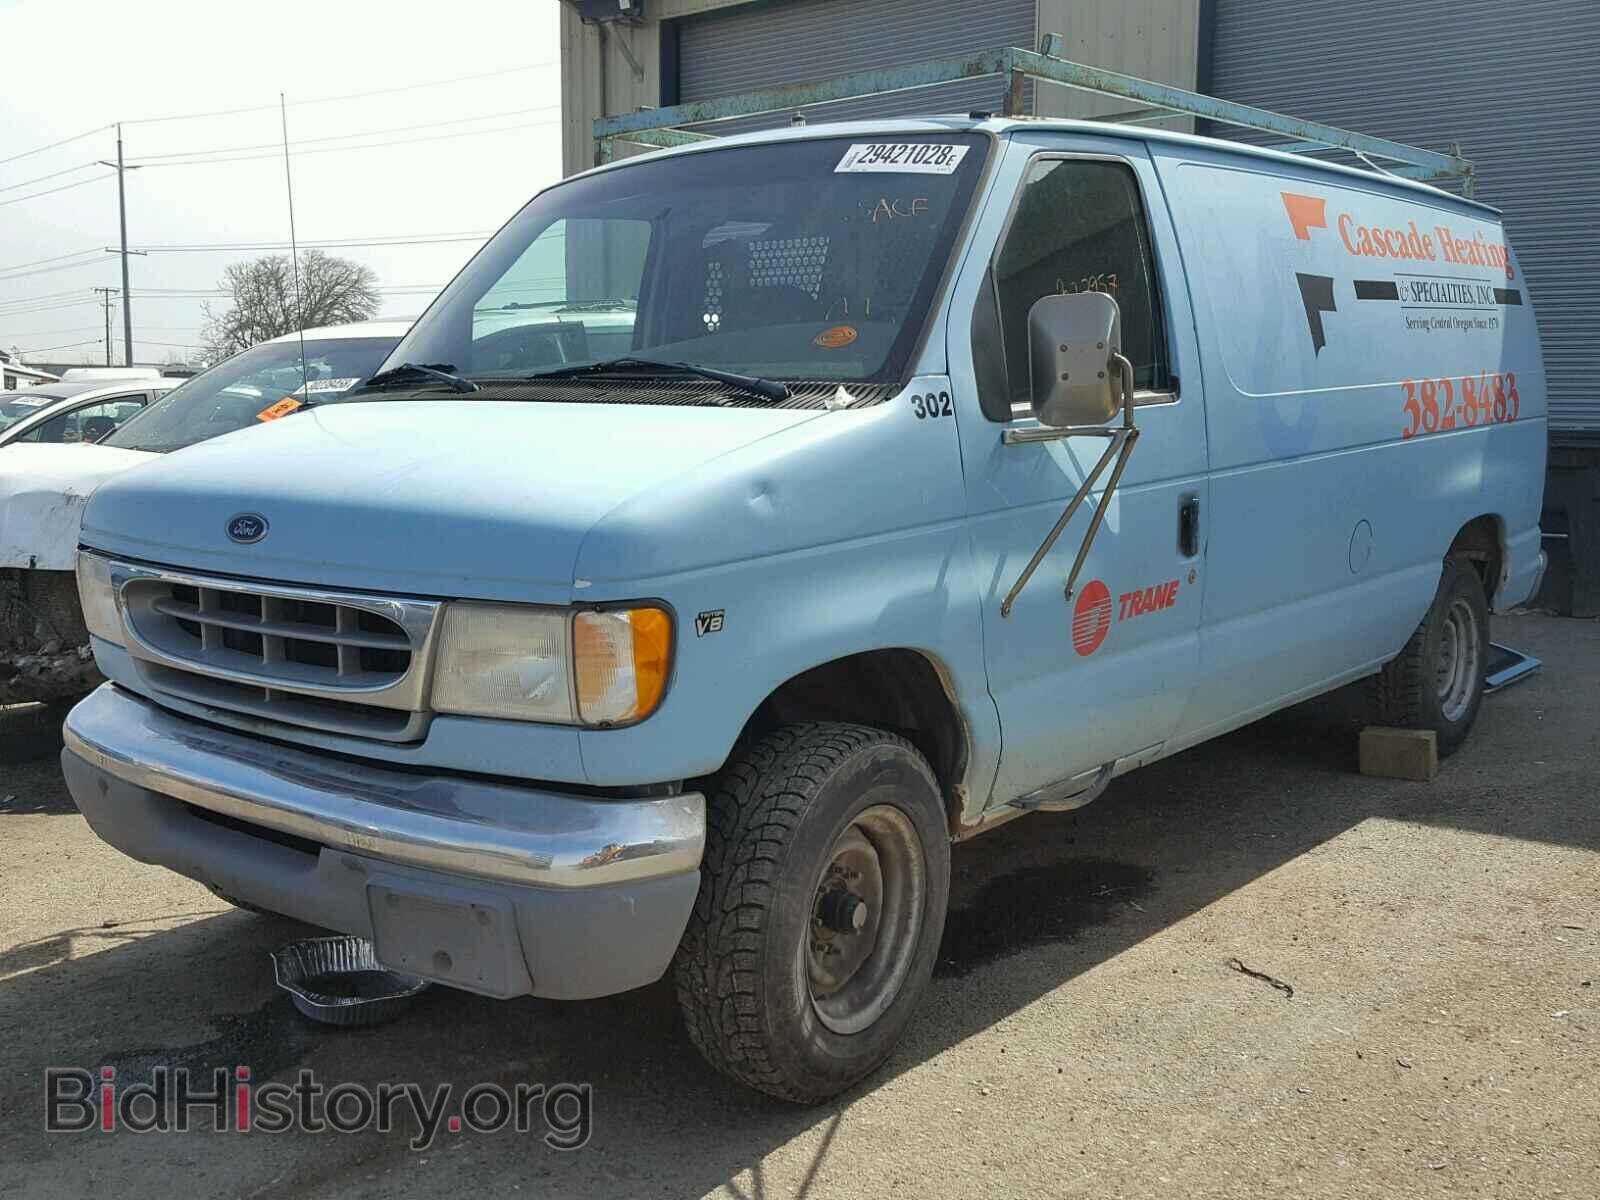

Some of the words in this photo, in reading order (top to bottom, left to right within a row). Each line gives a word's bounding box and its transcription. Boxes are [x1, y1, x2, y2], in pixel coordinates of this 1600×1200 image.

[1338, 213, 1436, 262] Cascade
[1434, 226, 1515, 281] Heating
[1400, 280, 1409, 302] &
[1477, 285, 1495, 305] INC.
[1406, 316, 1430, 334] Serving
[1431, 316, 1453, 329] Central
[1453, 316, 1473, 334] Oregon
[911, 391, 953, 419] 302
[1401, 369, 1520, 439] 382-8483
[233, 519, 258, 536] Ford
[1118, 580, 1181, 621] TRANE
[696, 616, 723, 637] V8
